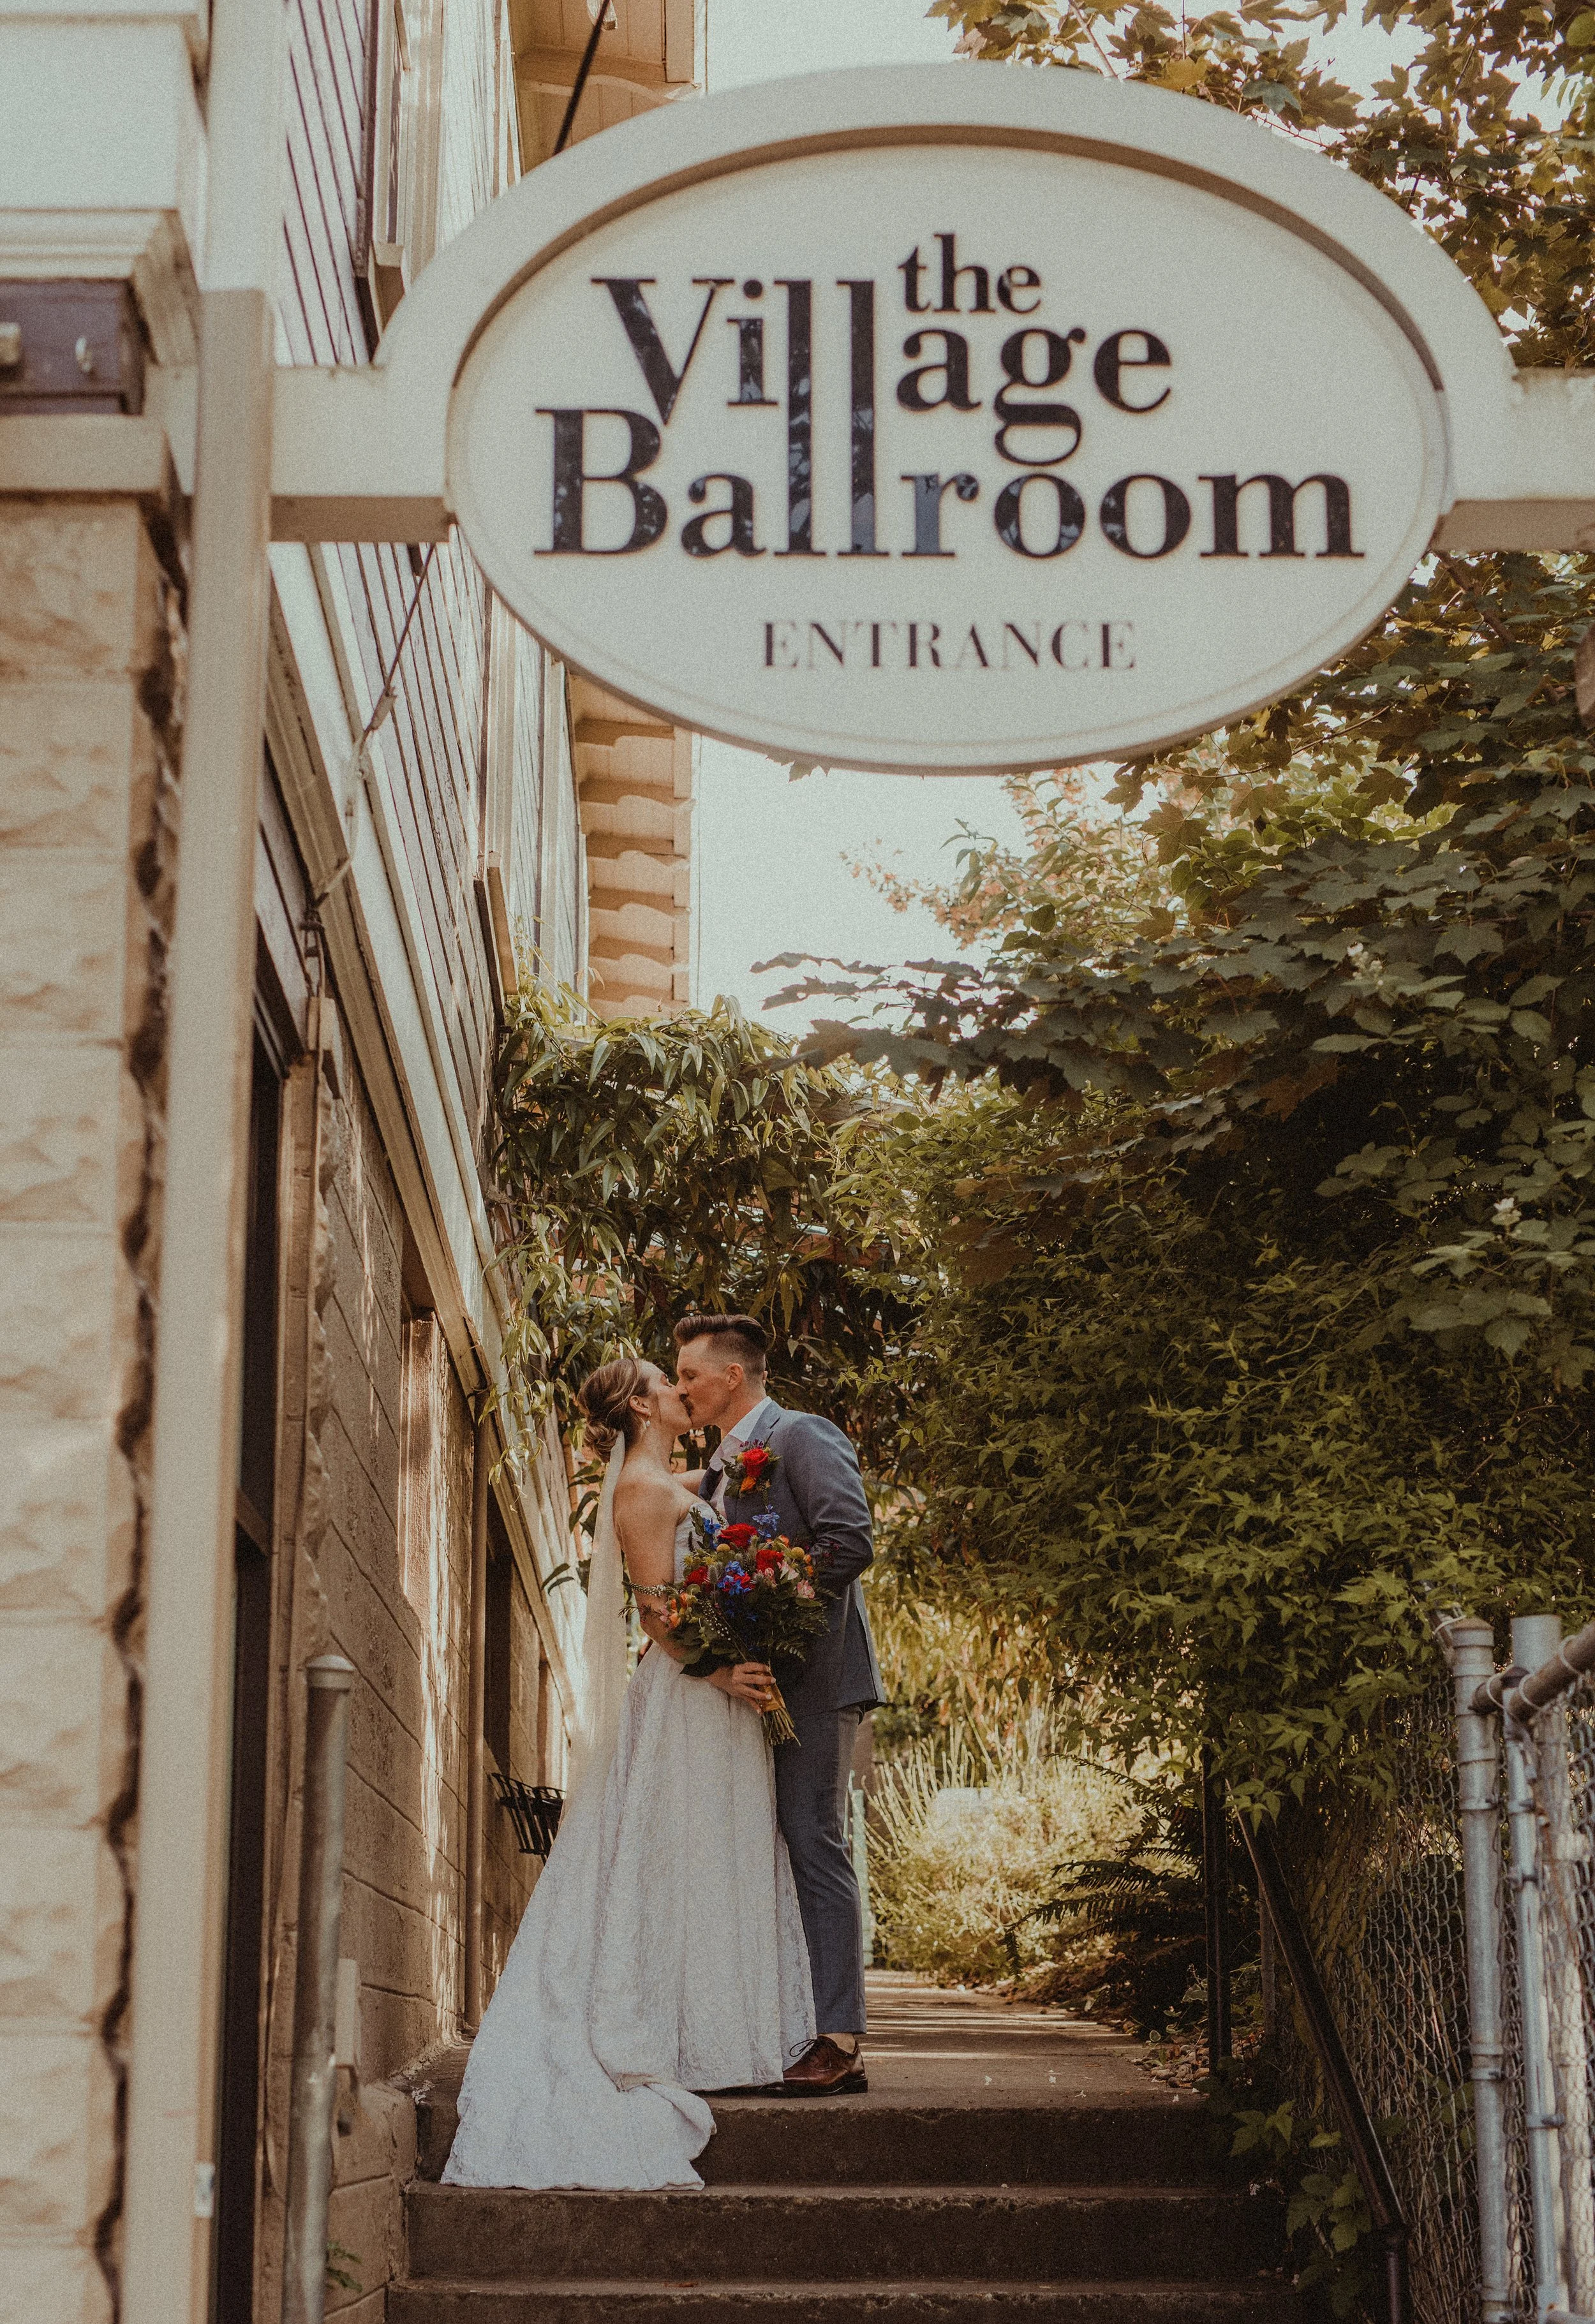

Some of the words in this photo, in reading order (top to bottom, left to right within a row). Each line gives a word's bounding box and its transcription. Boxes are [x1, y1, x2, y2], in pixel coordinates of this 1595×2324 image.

[896, 232, 1043, 316] the
[590, 276, 1172, 466] Village
[533, 406, 1367, 561] Ballroom
[762, 621, 1137, 670] ENTRANCE
